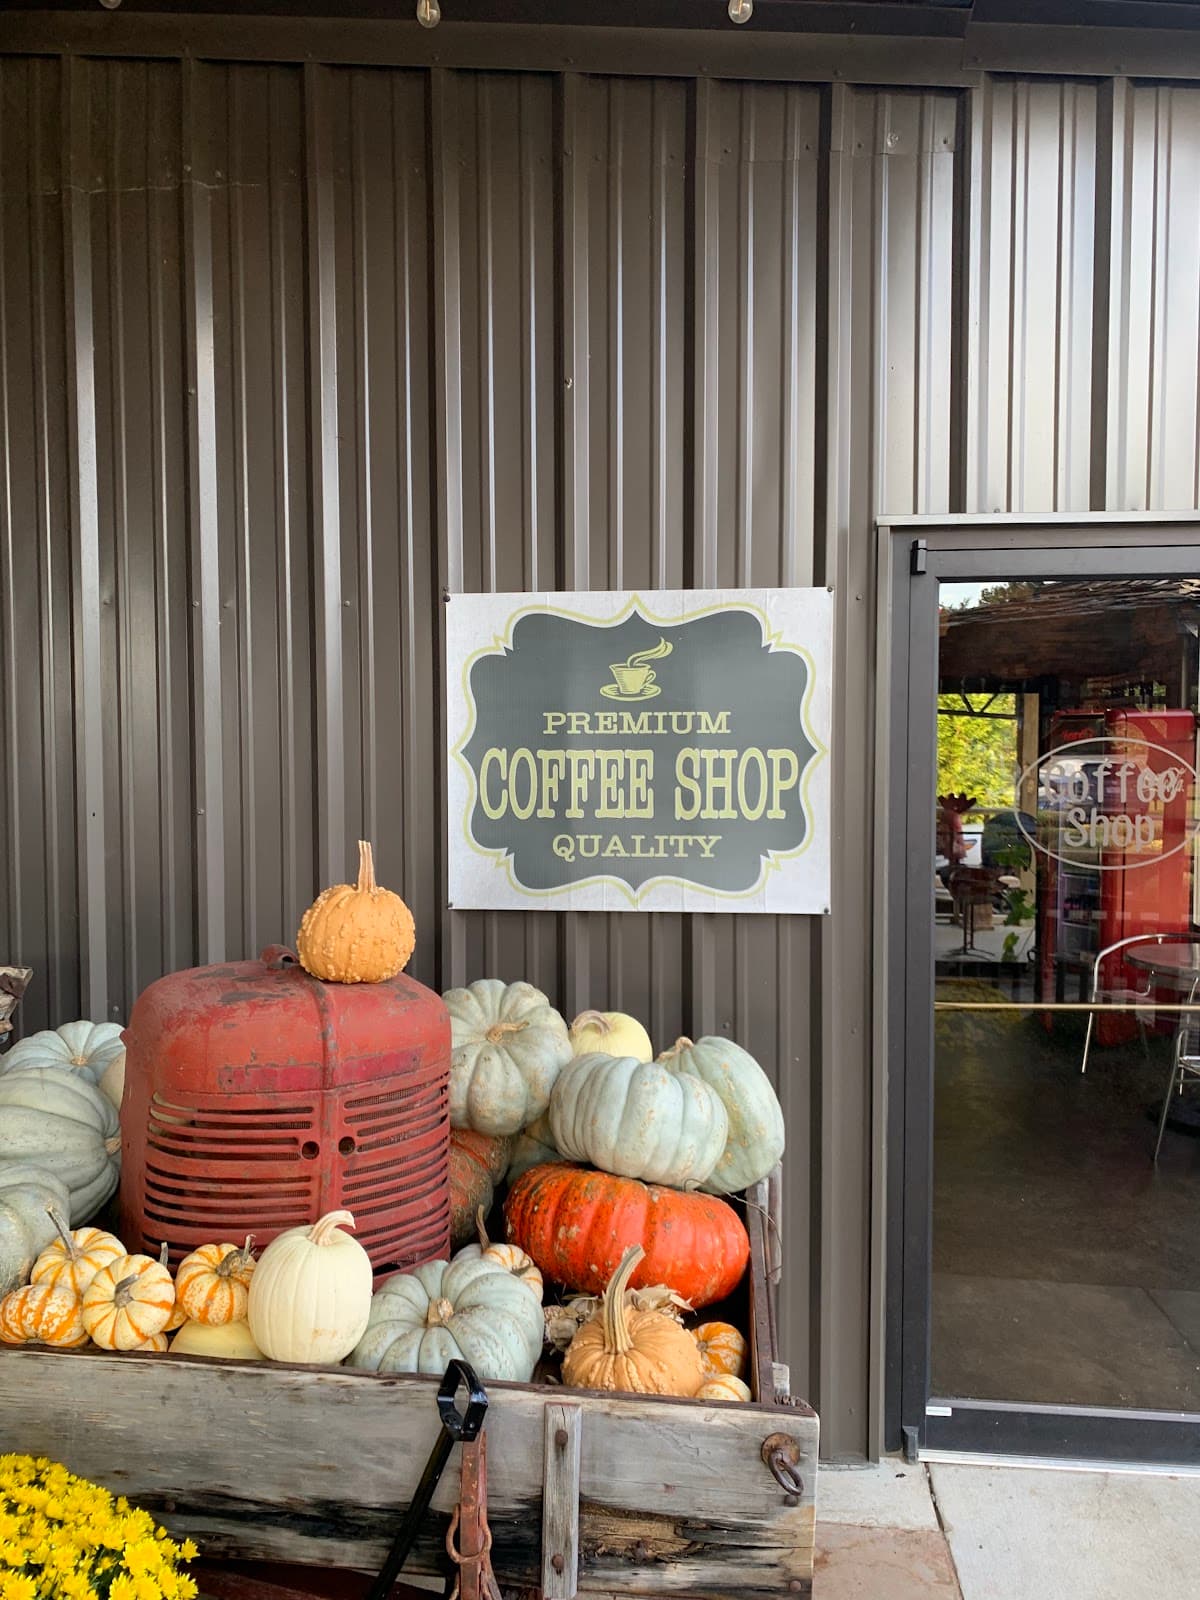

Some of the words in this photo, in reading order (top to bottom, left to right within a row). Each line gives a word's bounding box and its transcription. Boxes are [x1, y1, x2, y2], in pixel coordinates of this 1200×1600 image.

[543, 712, 731, 734] PREMIUM
[480, 747, 654, 820] COFFEE
[674, 747, 799, 820] SHOP
[1044, 761, 1177, 803] Coffee
[552, 834, 721, 862] QUALITY
[1063, 807, 1155, 853] Shop
